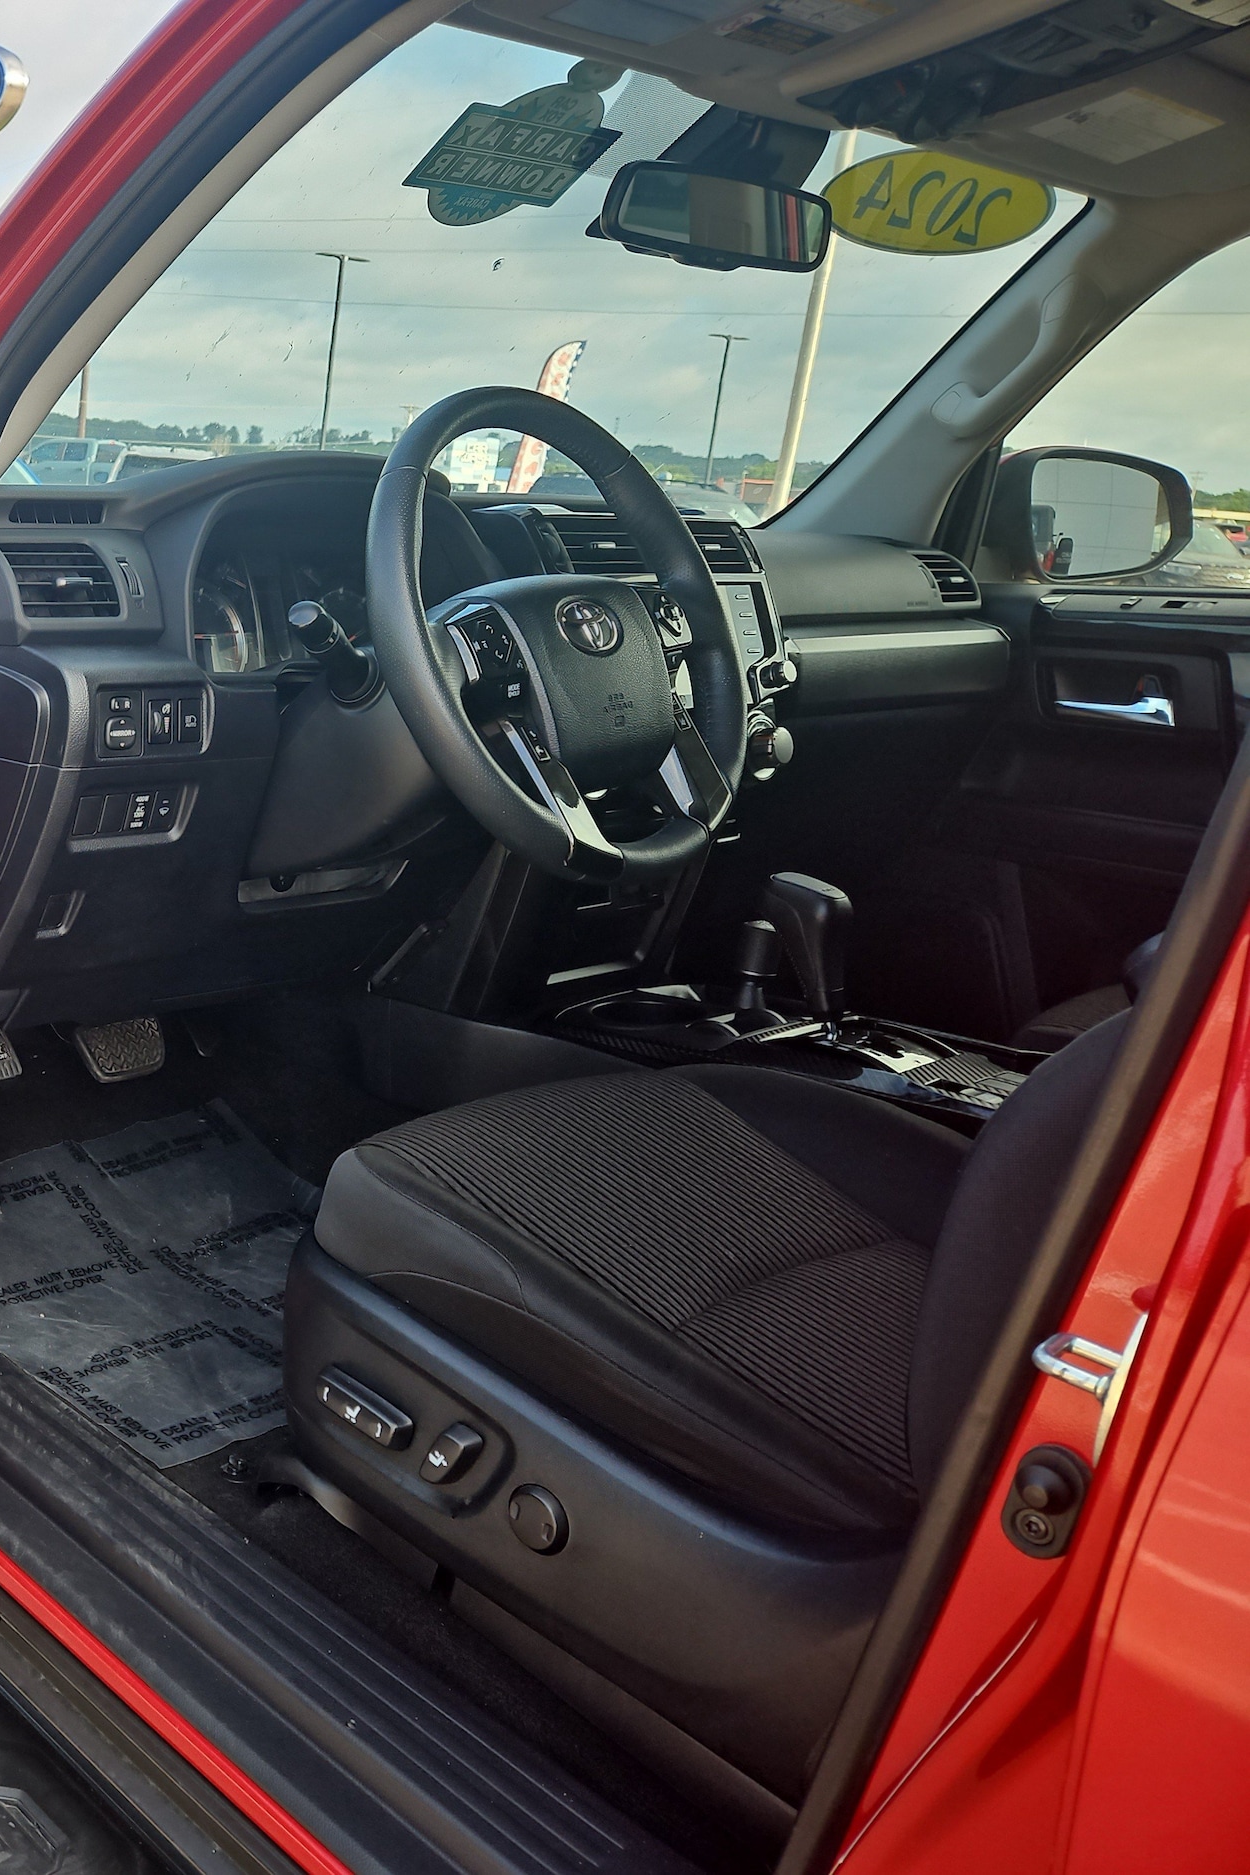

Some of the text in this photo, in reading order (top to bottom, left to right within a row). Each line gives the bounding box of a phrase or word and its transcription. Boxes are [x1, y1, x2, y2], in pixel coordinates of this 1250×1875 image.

[10, 1183, 53, 1202] DEALER
[79, 1213, 105, 1239] MUST
[96, 1219, 150, 1272] PROTECTIVE
[103, 1243, 138, 1275] DEALER
[33, 1271, 65, 1287] MUST
[67, 1259, 118, 1279] REMOVE
[63, 1274, 106, 1291] COVER
[160, 1246, 197, 1273] DEALER
[197, 1272, 228, 1289] MUST
[204, 1286, 243, 1311] COVER
[74, 1330, 213, 1379] DEALER MUST REMOVE
[88, 1323, 203, 1363] PROTECTIVE COVER
[36, 1370, 138, 1439] PROTECTIVE COVER
[49, 1366, 174, 1451] DEALER MUST REMOVE
[172, 1400, 286, 1445] PROTECTIVE COVE
[160, 1415, 212, 1438] DEALER
